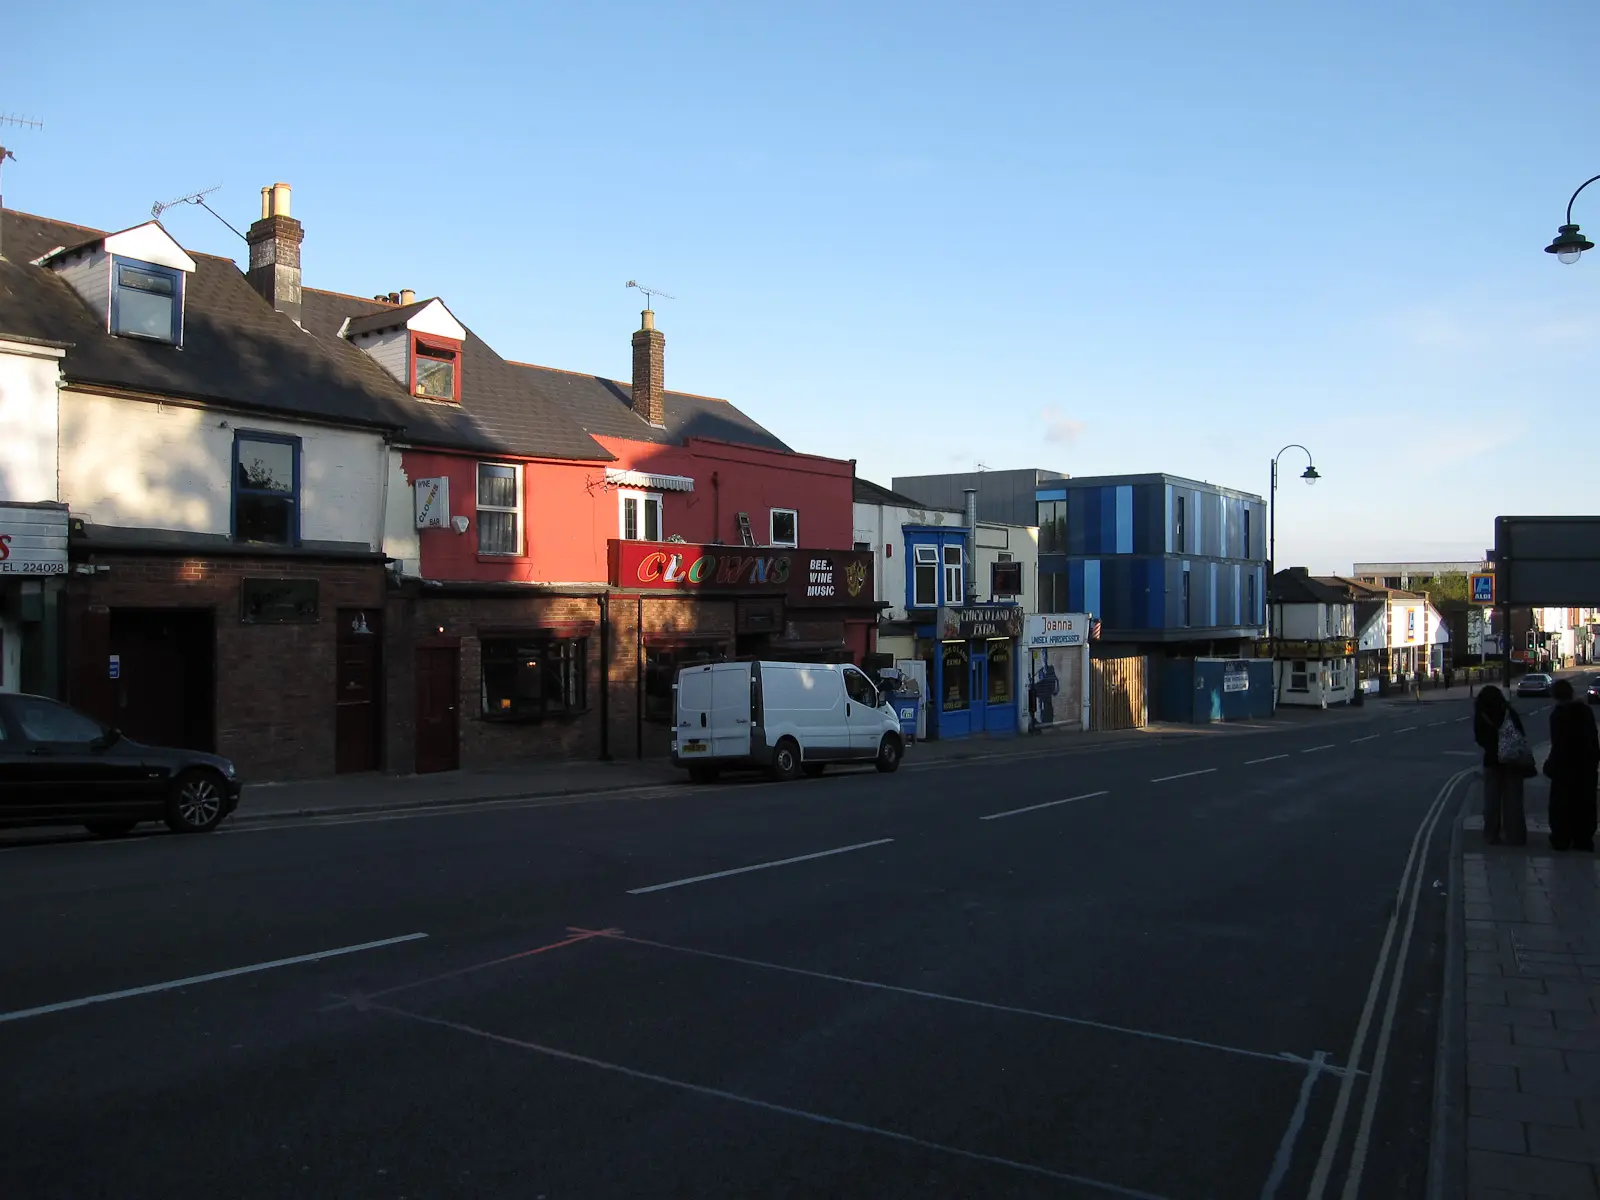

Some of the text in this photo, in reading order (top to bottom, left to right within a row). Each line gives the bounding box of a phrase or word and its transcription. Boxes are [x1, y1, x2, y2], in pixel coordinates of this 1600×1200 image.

[429, 518, 440, 526] BAR
[0, 562, 64, 573] EL. 224028
[636, 551, 791, 584] CLOWNS
[809, 572, 833, 583] WINE
[807, 585, 836, 597] MUSIC
[973, 623, 996, 635] EXTRA
[1041, 617, 1072, 635] Joanna
